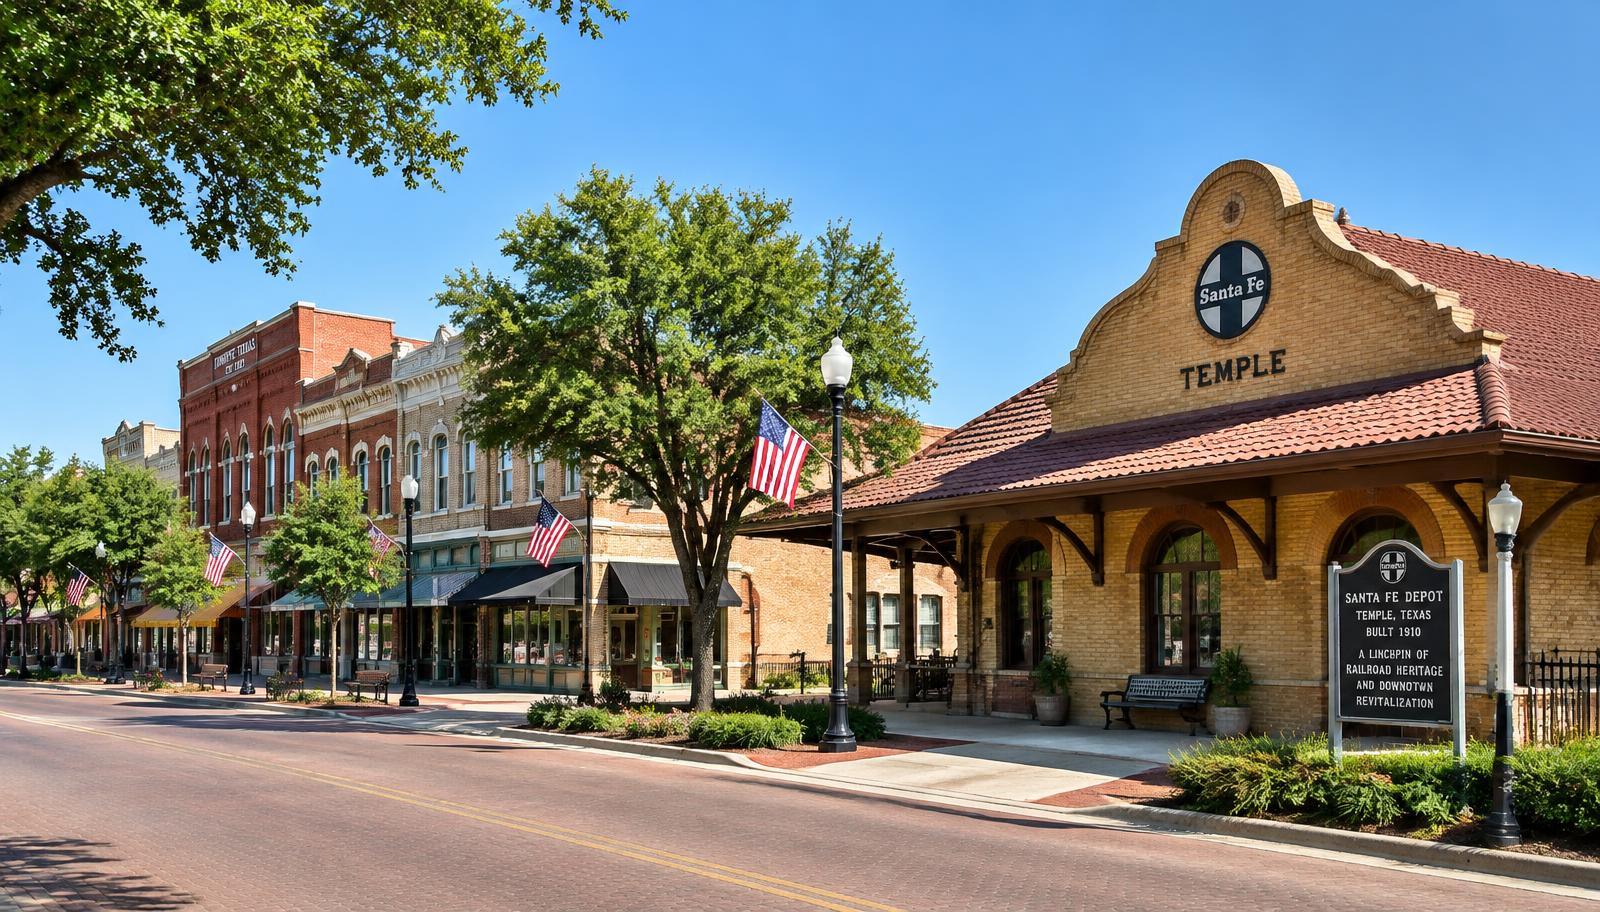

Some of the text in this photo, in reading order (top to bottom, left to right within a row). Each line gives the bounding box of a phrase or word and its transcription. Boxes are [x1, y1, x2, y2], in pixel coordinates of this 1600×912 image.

[1200, 277, 1264, 304] Santa Fe
[1180, 349, 1286, 389] TEMPLE
[1346, 590, 1442, 604] SANTA FE DEPOT
[1356, 610, 1431, 621] TEMPLE, TEXAS
[1399, 627, 1421, 637] 1910
[1359, 650, 1365, 659] A
[1417, 650, 1428, 660] OF
[1347, 664, 1443, 677] RAILROAD HERITAGE
[1357, 680, 1374, 690] AND
[1357, 696, 1433, 709] REVITALIZATION
